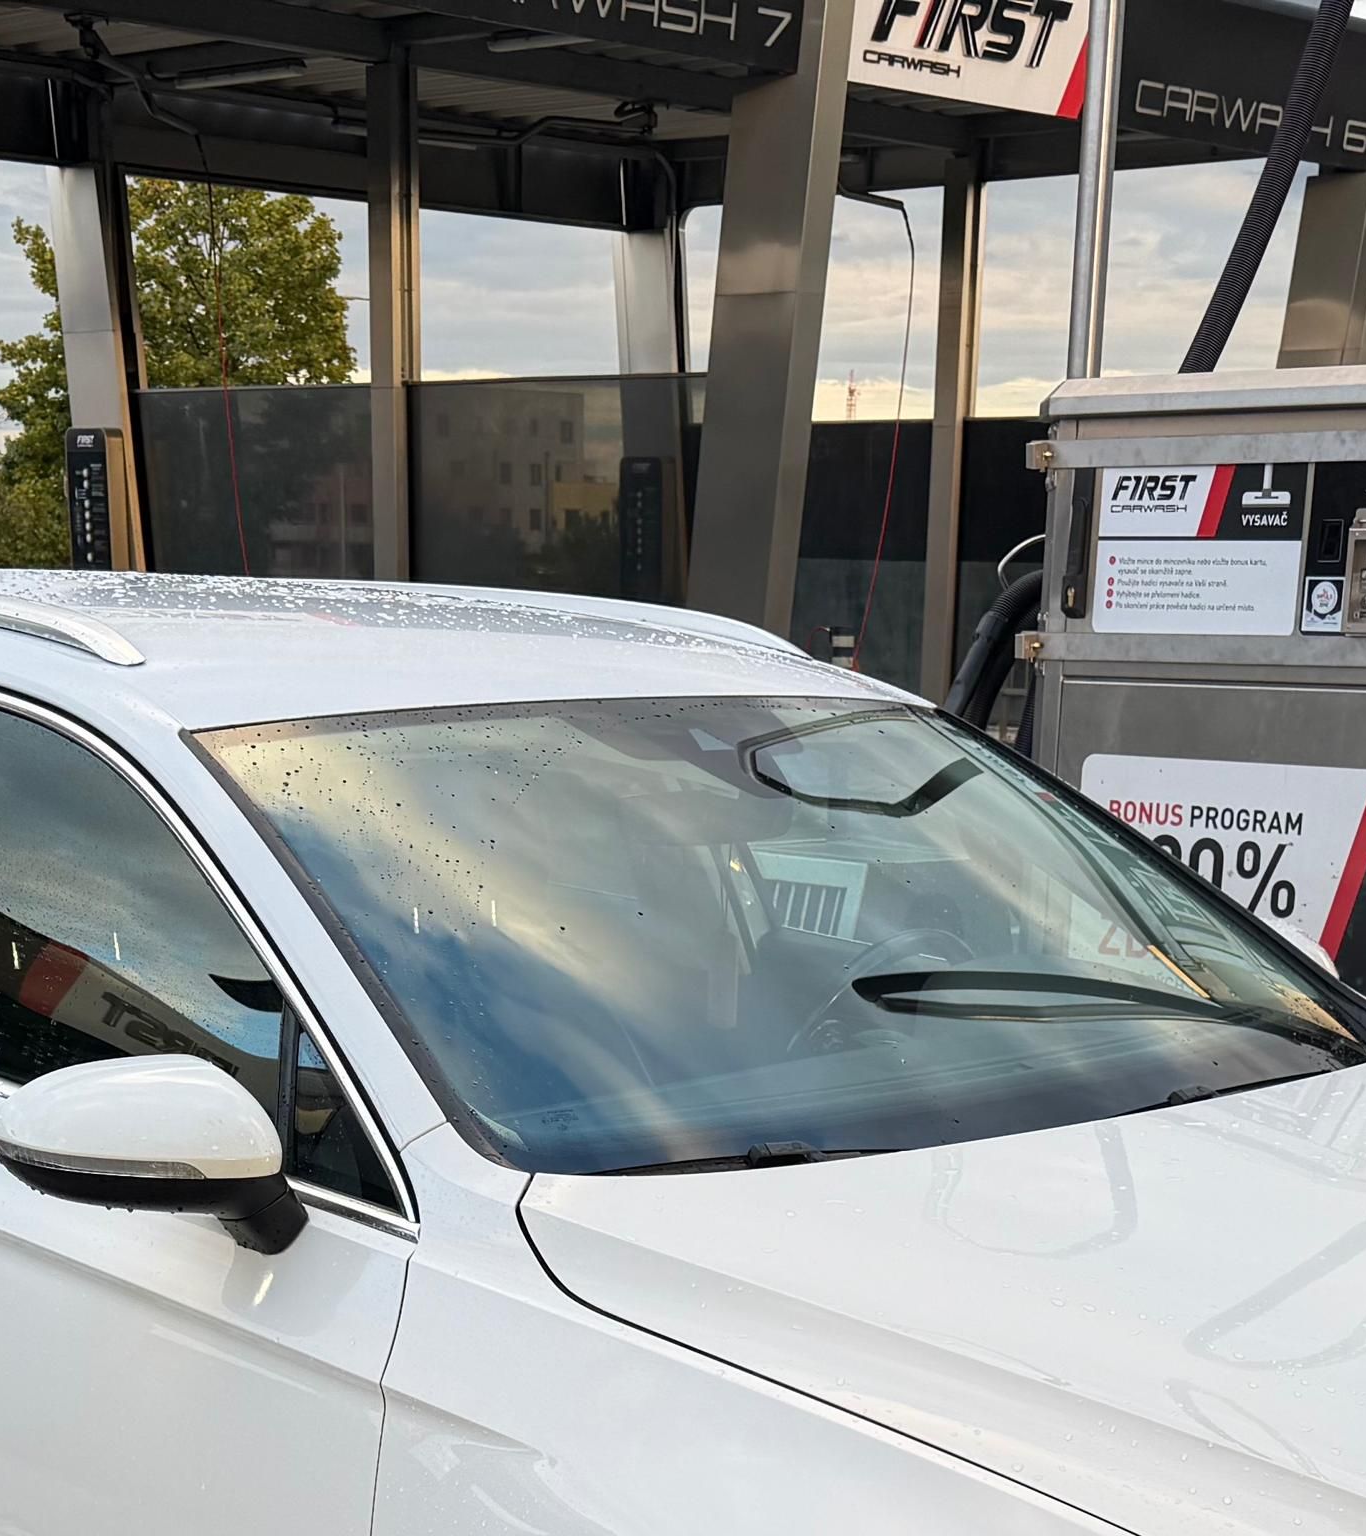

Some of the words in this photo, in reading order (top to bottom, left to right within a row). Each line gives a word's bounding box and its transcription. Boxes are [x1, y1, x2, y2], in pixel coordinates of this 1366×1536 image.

[757, 7, 792, 47] 7
[863, 49, 961, 78] CARWASH
[1135, 79, 1334, 147] CARWAH
[1110, 504, 1187, 513] CARWASH
[1241, 512, 1288, 527] VYSAVAČ
[1108, 799, 1183, 827] BONUS
[1189, 805, 1304, 836] PROGRAM
